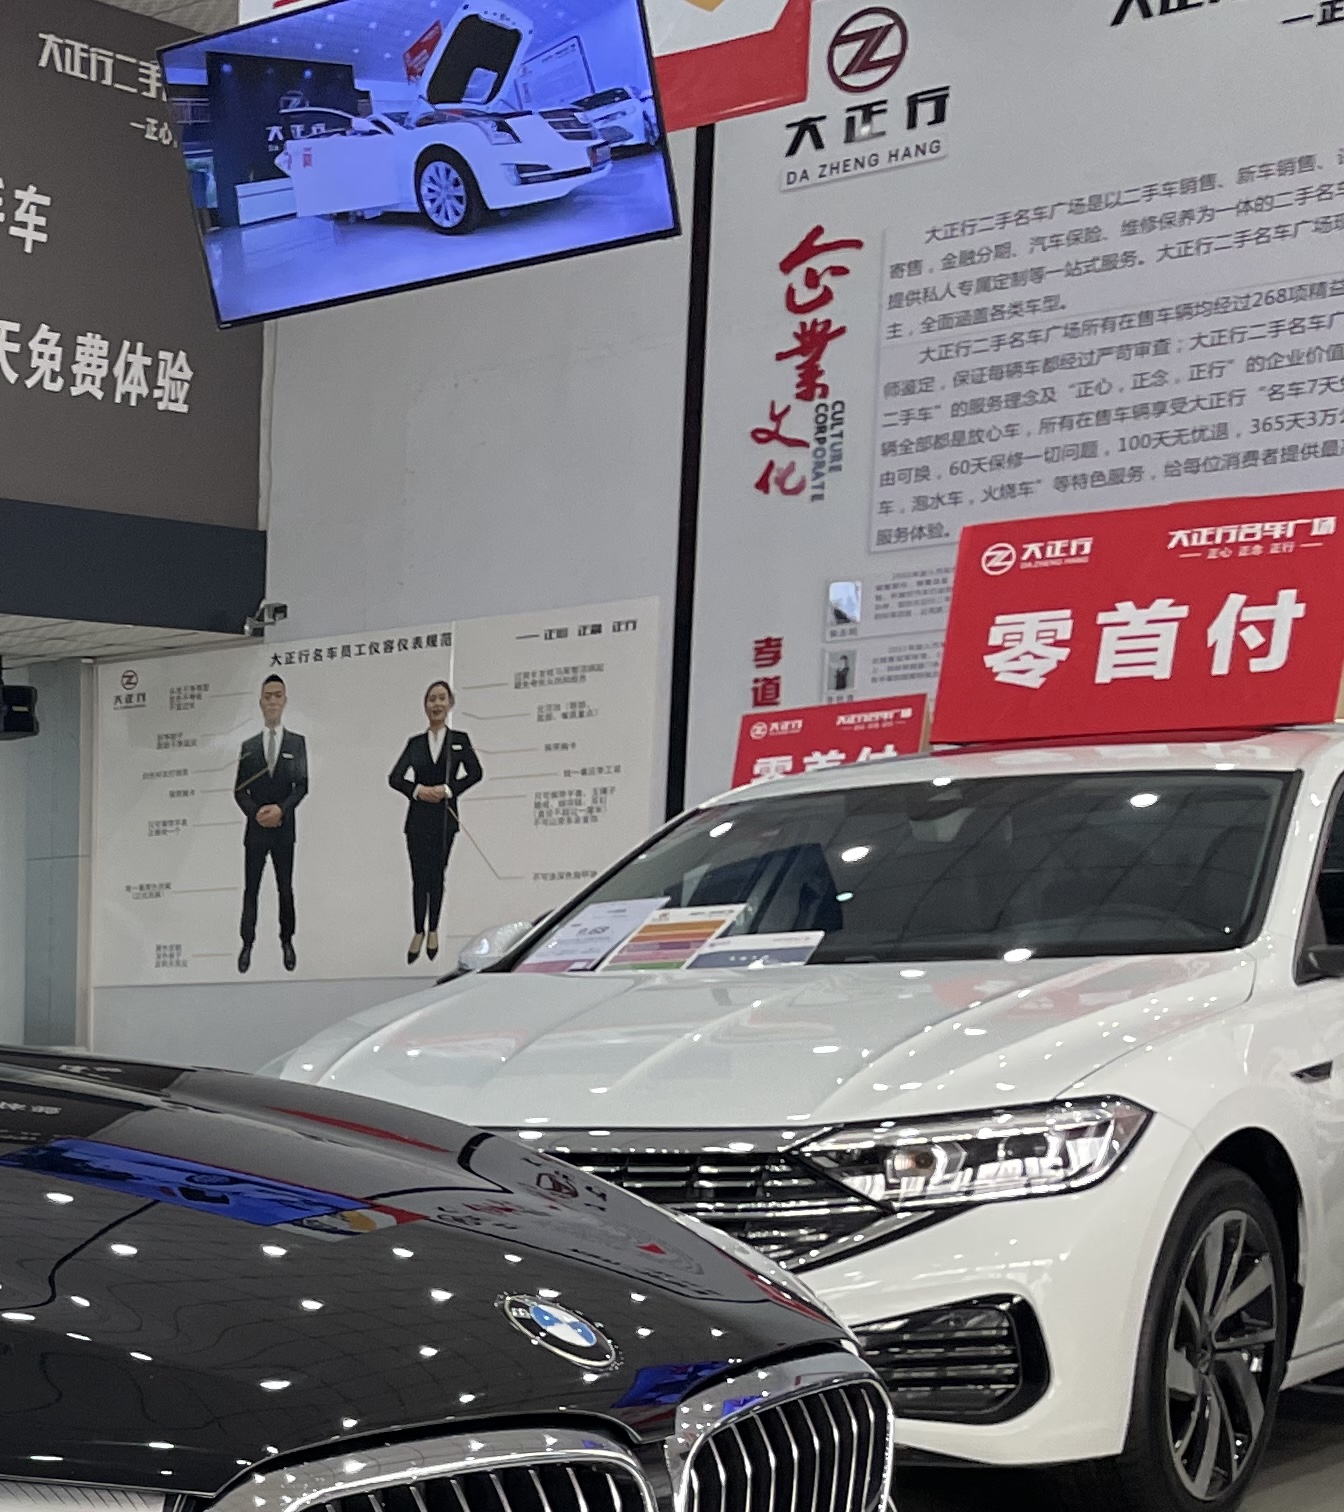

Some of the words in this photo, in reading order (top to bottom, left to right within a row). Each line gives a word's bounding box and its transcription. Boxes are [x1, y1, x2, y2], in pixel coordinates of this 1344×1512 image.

[38, 32, 168, 102] 大正行二手
[785, 85, 950, 158] 大正行
[786, 169, 810, 185] DA
[819, 153, 880, 178] ZHENG
[888, 140, 942, 163] HANG
[811, 402, 829, 503] CORPORATE
[828, 399, 846, 473] CULTURE
[1021, 537, 1094, 561] 大正行
[1168, 516, 1337, 549] 大正行名车广场
[983, 589, 1307, 689] 零首付
